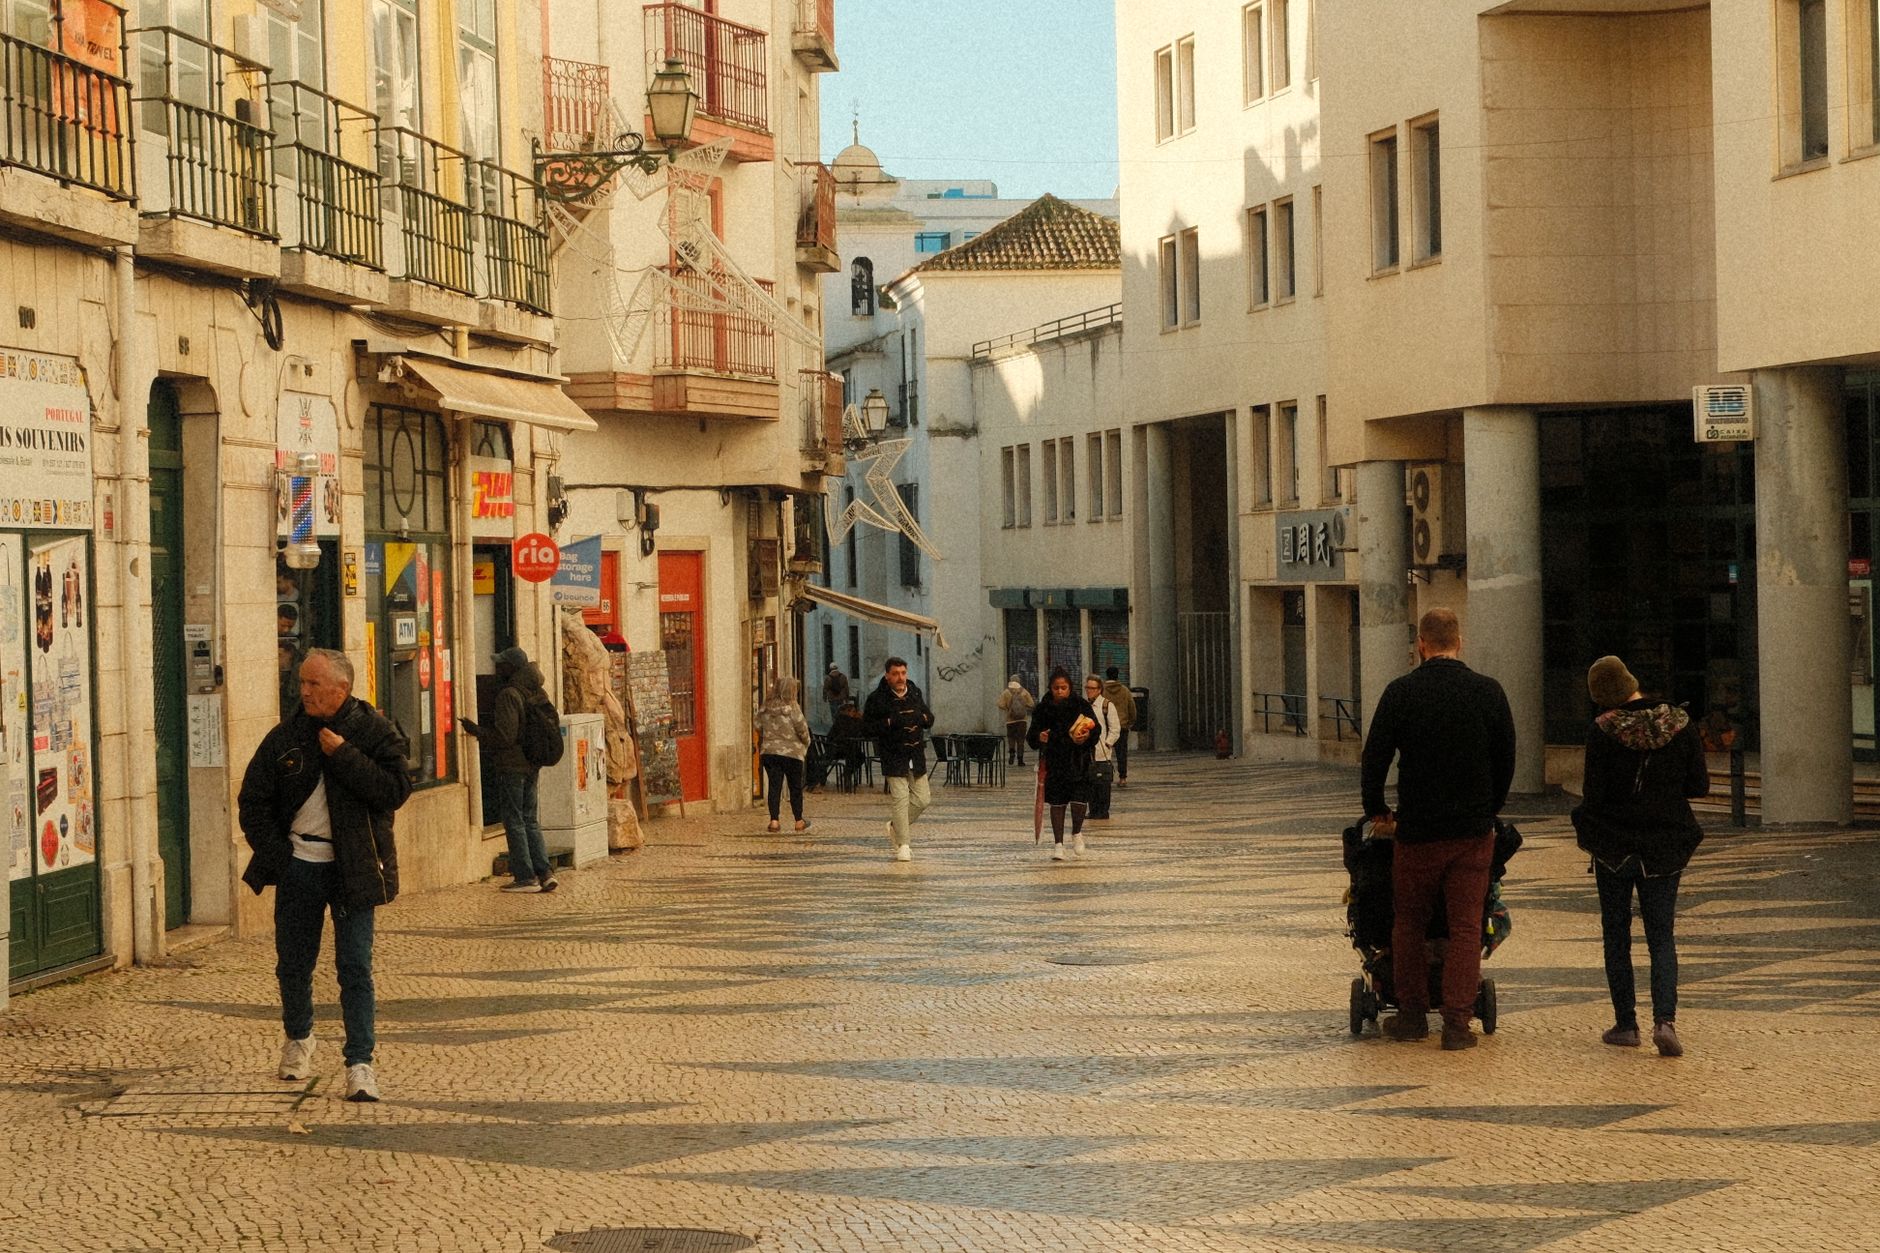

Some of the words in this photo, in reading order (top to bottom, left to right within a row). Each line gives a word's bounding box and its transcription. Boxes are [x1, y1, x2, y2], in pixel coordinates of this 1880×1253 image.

[45, 407, 84, 424] PORTUGAL
[15, 427, 85, 453] SOUVENIRS
[518, 538, 555, 564] ria
[1296, 522, 1331, 568] 周氏
[569, 571, 593, 582] here
[563, 592, 595, 602] bounce
[398, 622, 415, 639] ATM
